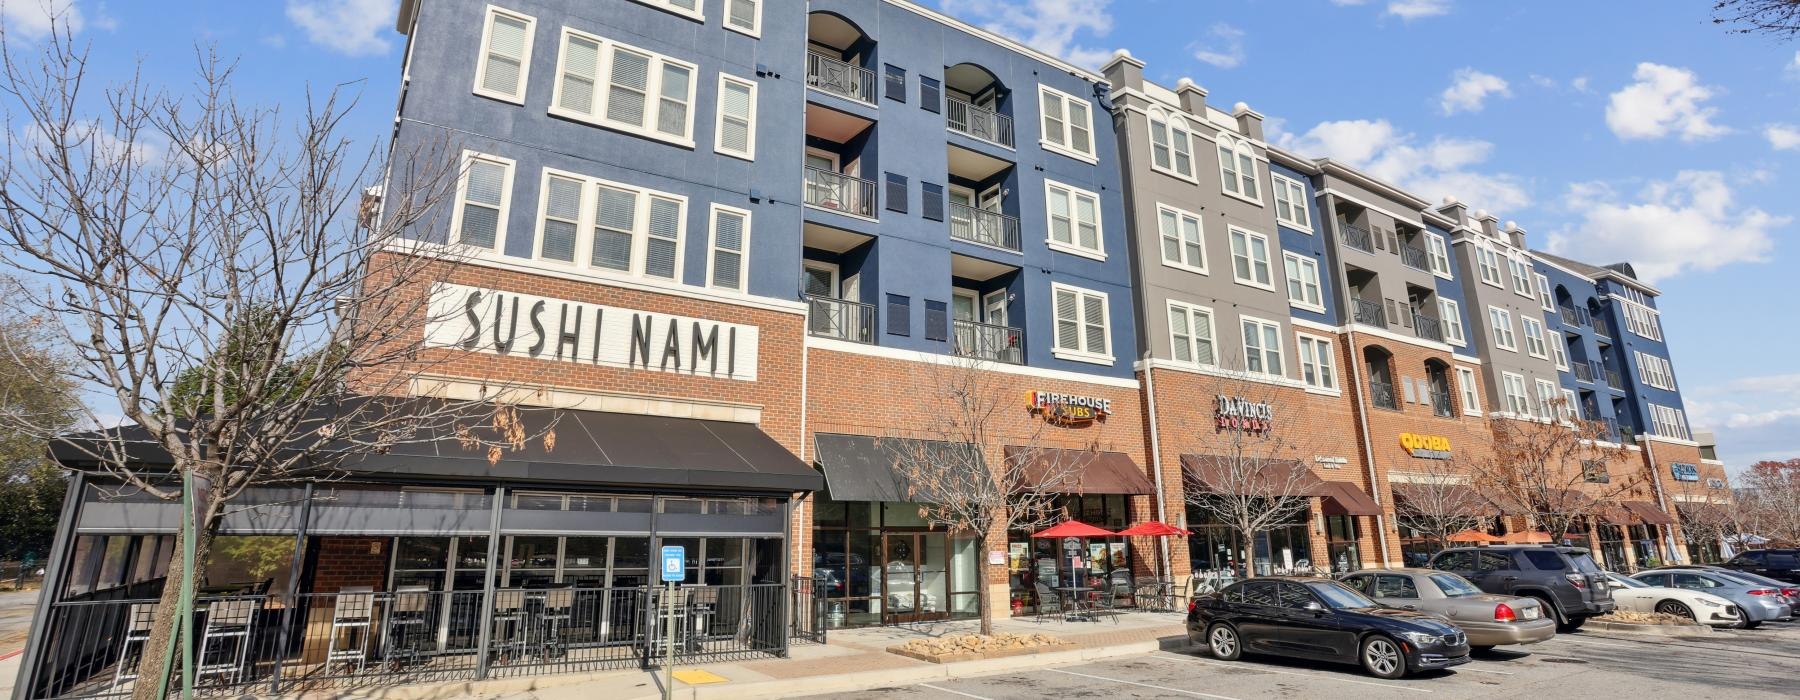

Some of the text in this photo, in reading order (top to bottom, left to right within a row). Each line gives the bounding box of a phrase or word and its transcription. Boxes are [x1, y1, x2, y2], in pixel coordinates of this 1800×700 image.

[462, 289, 737, 377] SUSHI NAMI
[1036, 391, 1112, 415] FIREHOUSE
[1400, 432, 1452, 452] QDOBA
